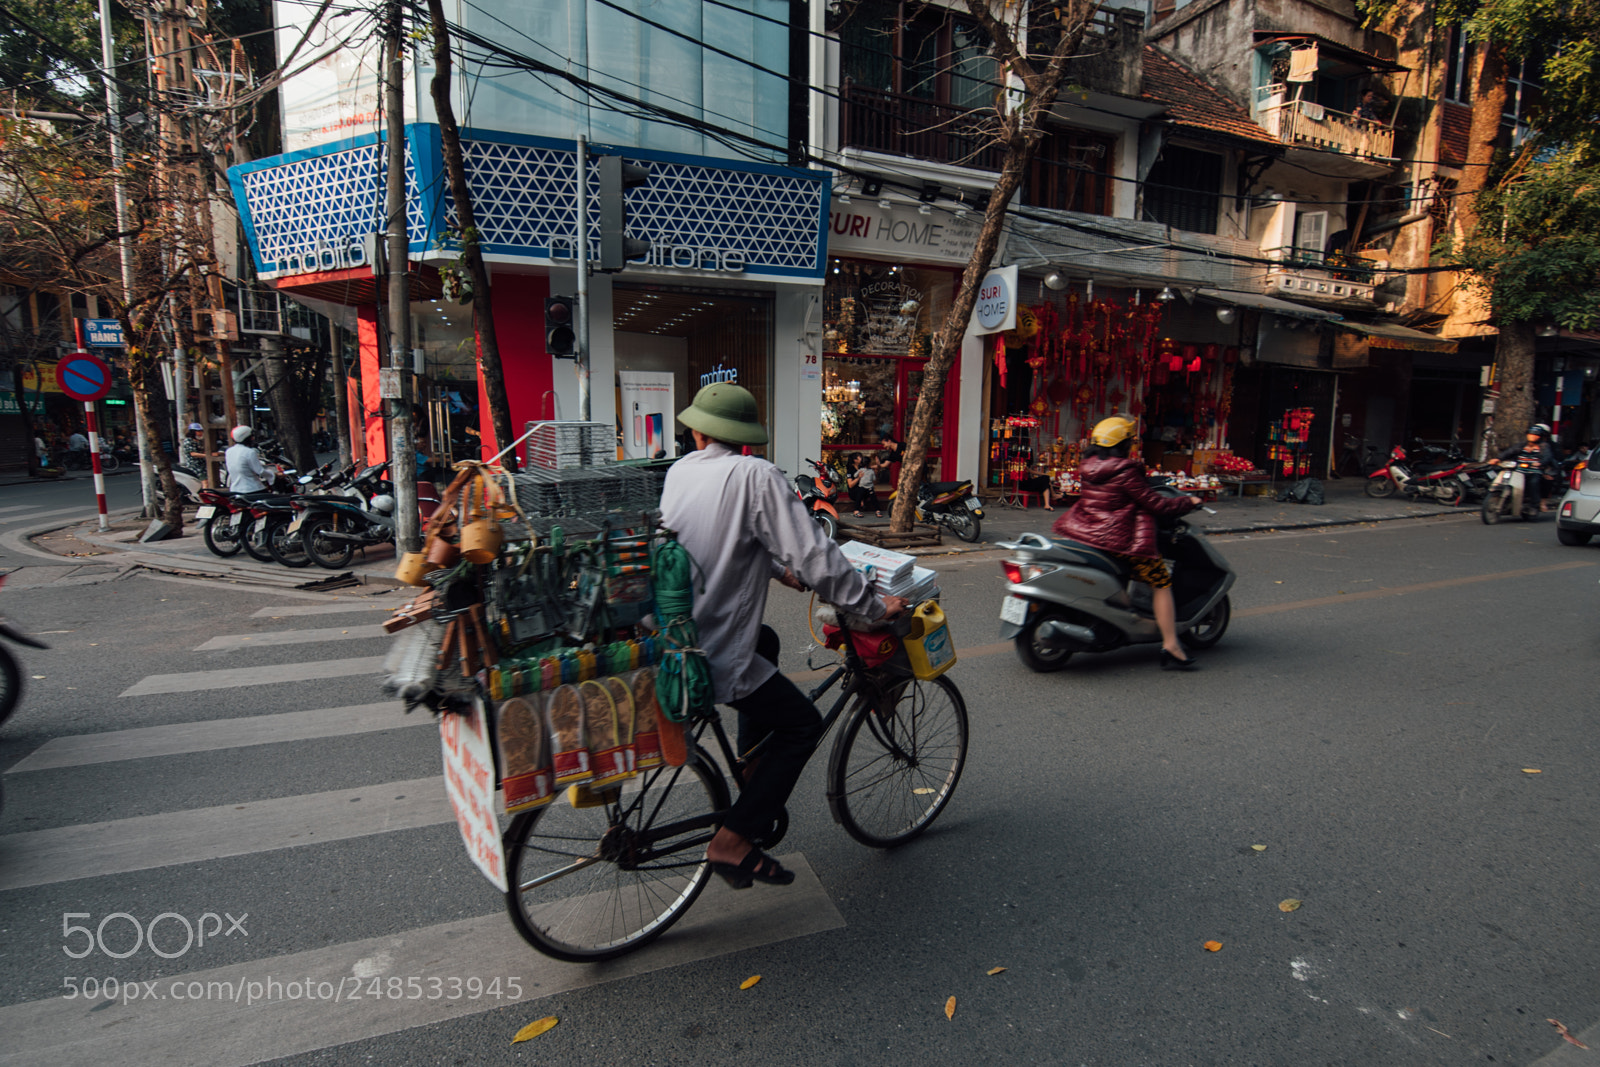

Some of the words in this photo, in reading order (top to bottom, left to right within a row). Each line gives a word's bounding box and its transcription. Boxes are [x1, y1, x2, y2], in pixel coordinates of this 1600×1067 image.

[876, 218, 944, 246] HOME
[277, 234, 390, 276] mobifo
[860, 281, 925, 301] DECORATION
[980, 285, 1002, 301] SURI
[977, 301, 1006, 318] HOME
[90, 330, 118, 343] HÀNG
[805, 355, 817, 364] 78
